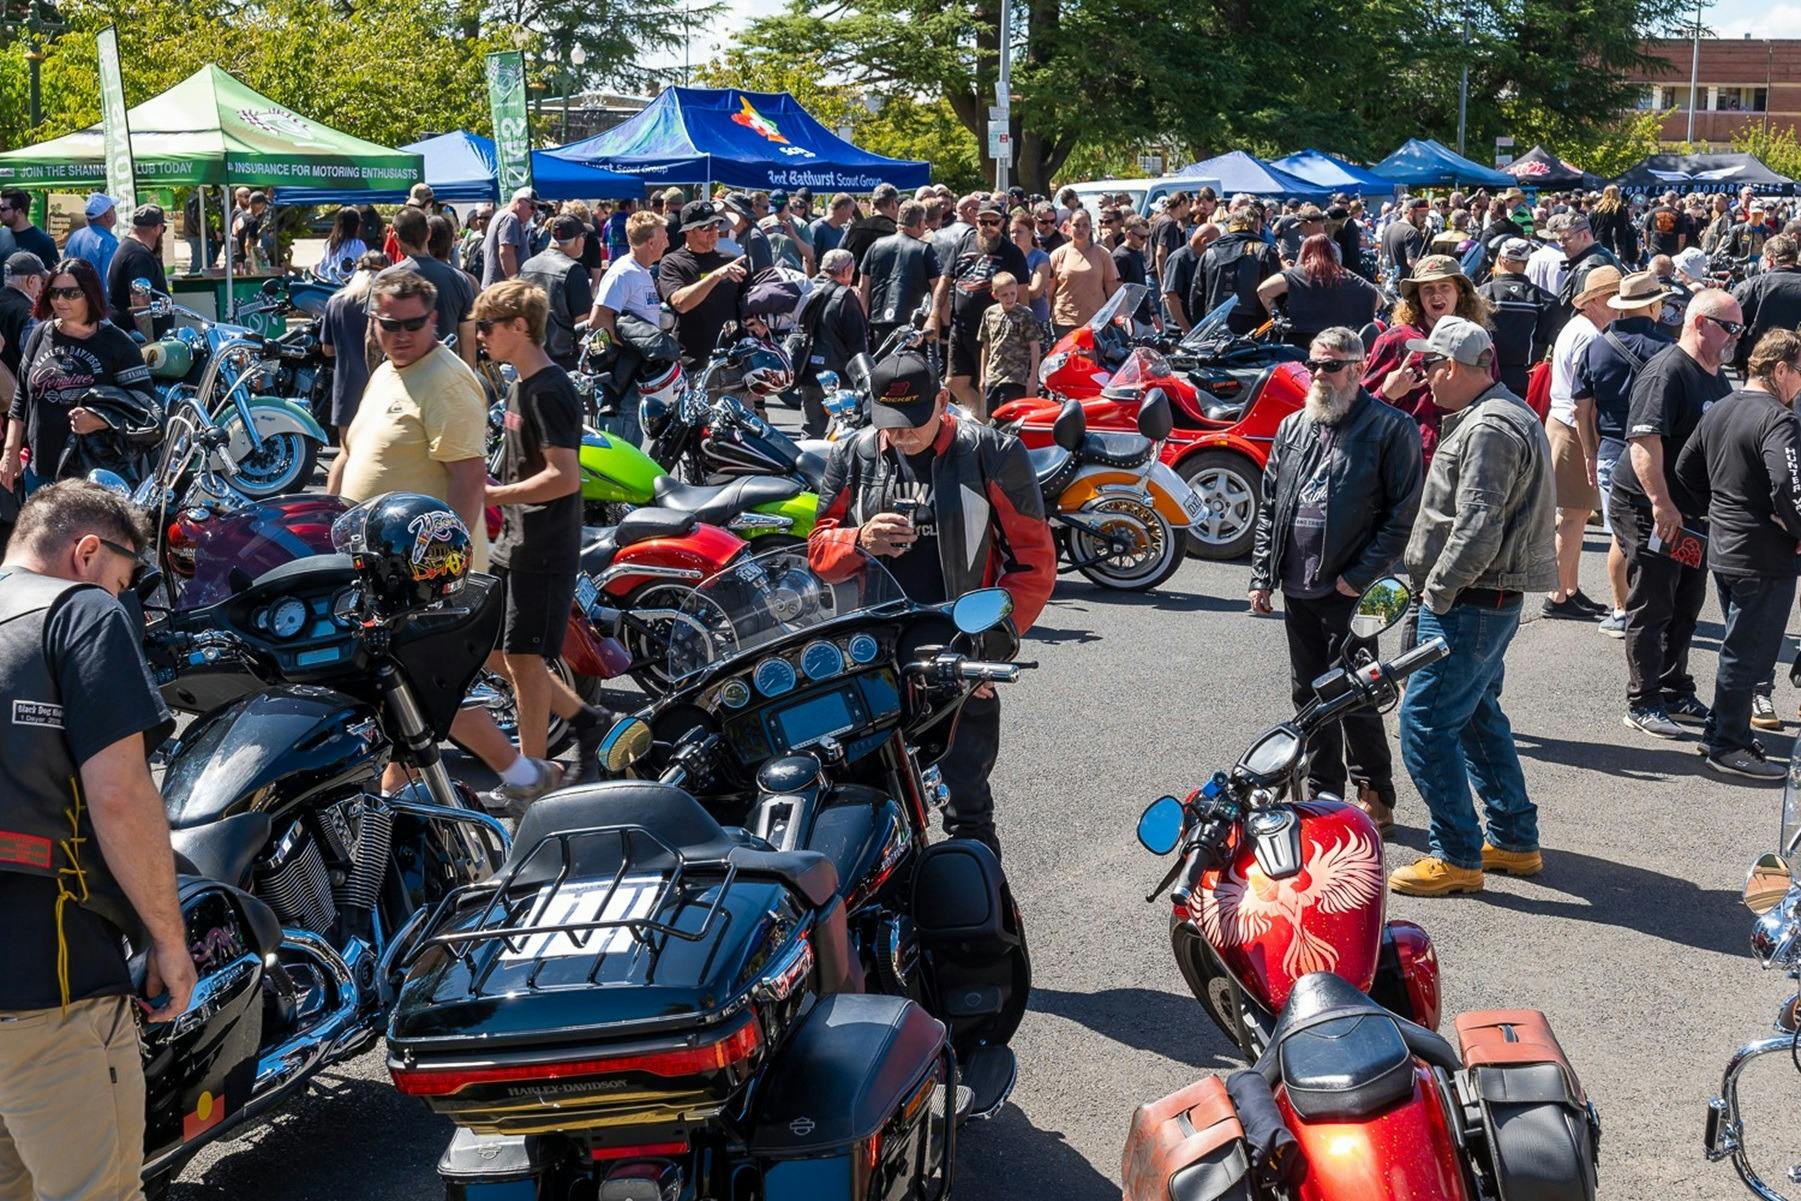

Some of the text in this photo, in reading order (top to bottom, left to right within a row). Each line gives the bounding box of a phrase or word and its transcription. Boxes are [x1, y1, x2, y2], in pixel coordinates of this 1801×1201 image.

[20, 167, 43, 178] JOIN
[47, 166, 66, 176] THE
[136, 163, 155, 174] LUB
[159, 162, 192, 173] TODAY
[235, 162, 418, 179] INSURANCE FOR MOTORING ENTHUSIASTS
[788, 170, 835, 187] Bathurst
[836, 173, 859, 187] Scout
[17, 704, 37, 714] Black
[507, 1079, 629, 1097] HARLEY-DAVIDSON
